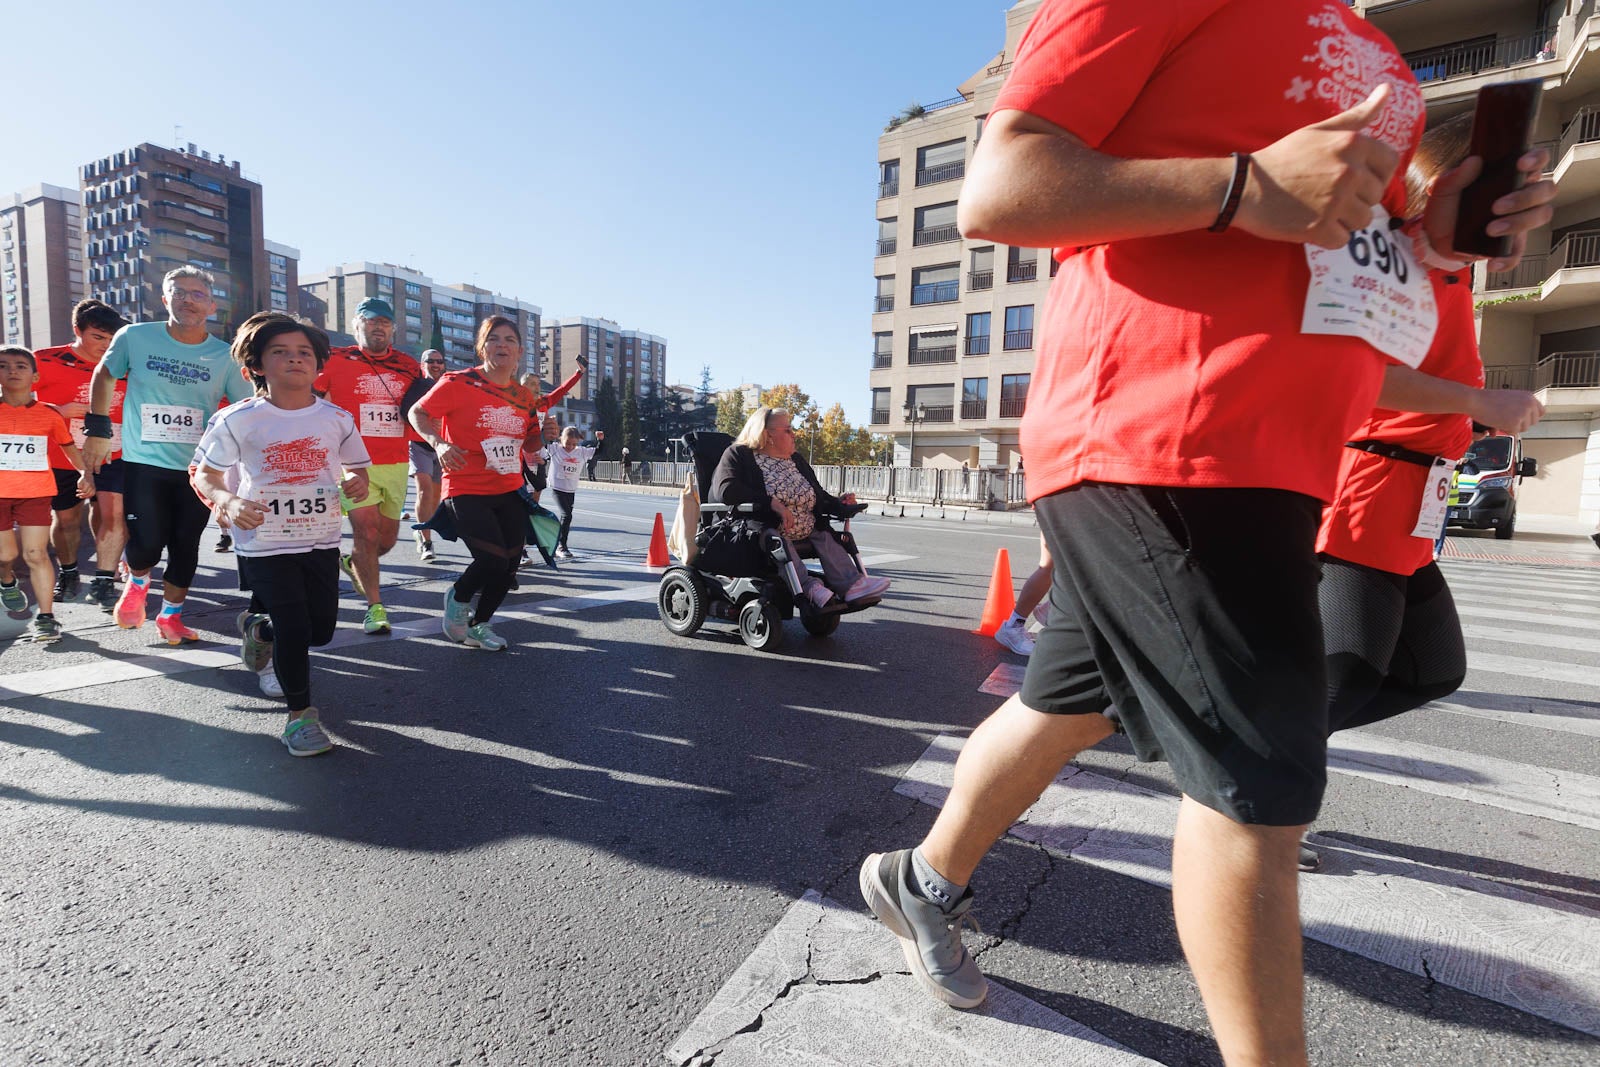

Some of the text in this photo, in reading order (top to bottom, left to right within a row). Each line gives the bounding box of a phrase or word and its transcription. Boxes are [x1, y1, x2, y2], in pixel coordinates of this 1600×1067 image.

[1347, 228, 1408, 285] 690
[148, 354, 169, 362] BANK
[181, 361, 210, 372] AMERICA
[146, 360, 211, 382] CHICAGO
[157, 372, 198, 384] MARATHON
[151, 413, 193, 427] 1048
[367, 411, 399, 422] 1134
[1, 442, 36, 454] 776
[492, 445, 515, 458] 1133
[268, 498, 327, 515] 1135
